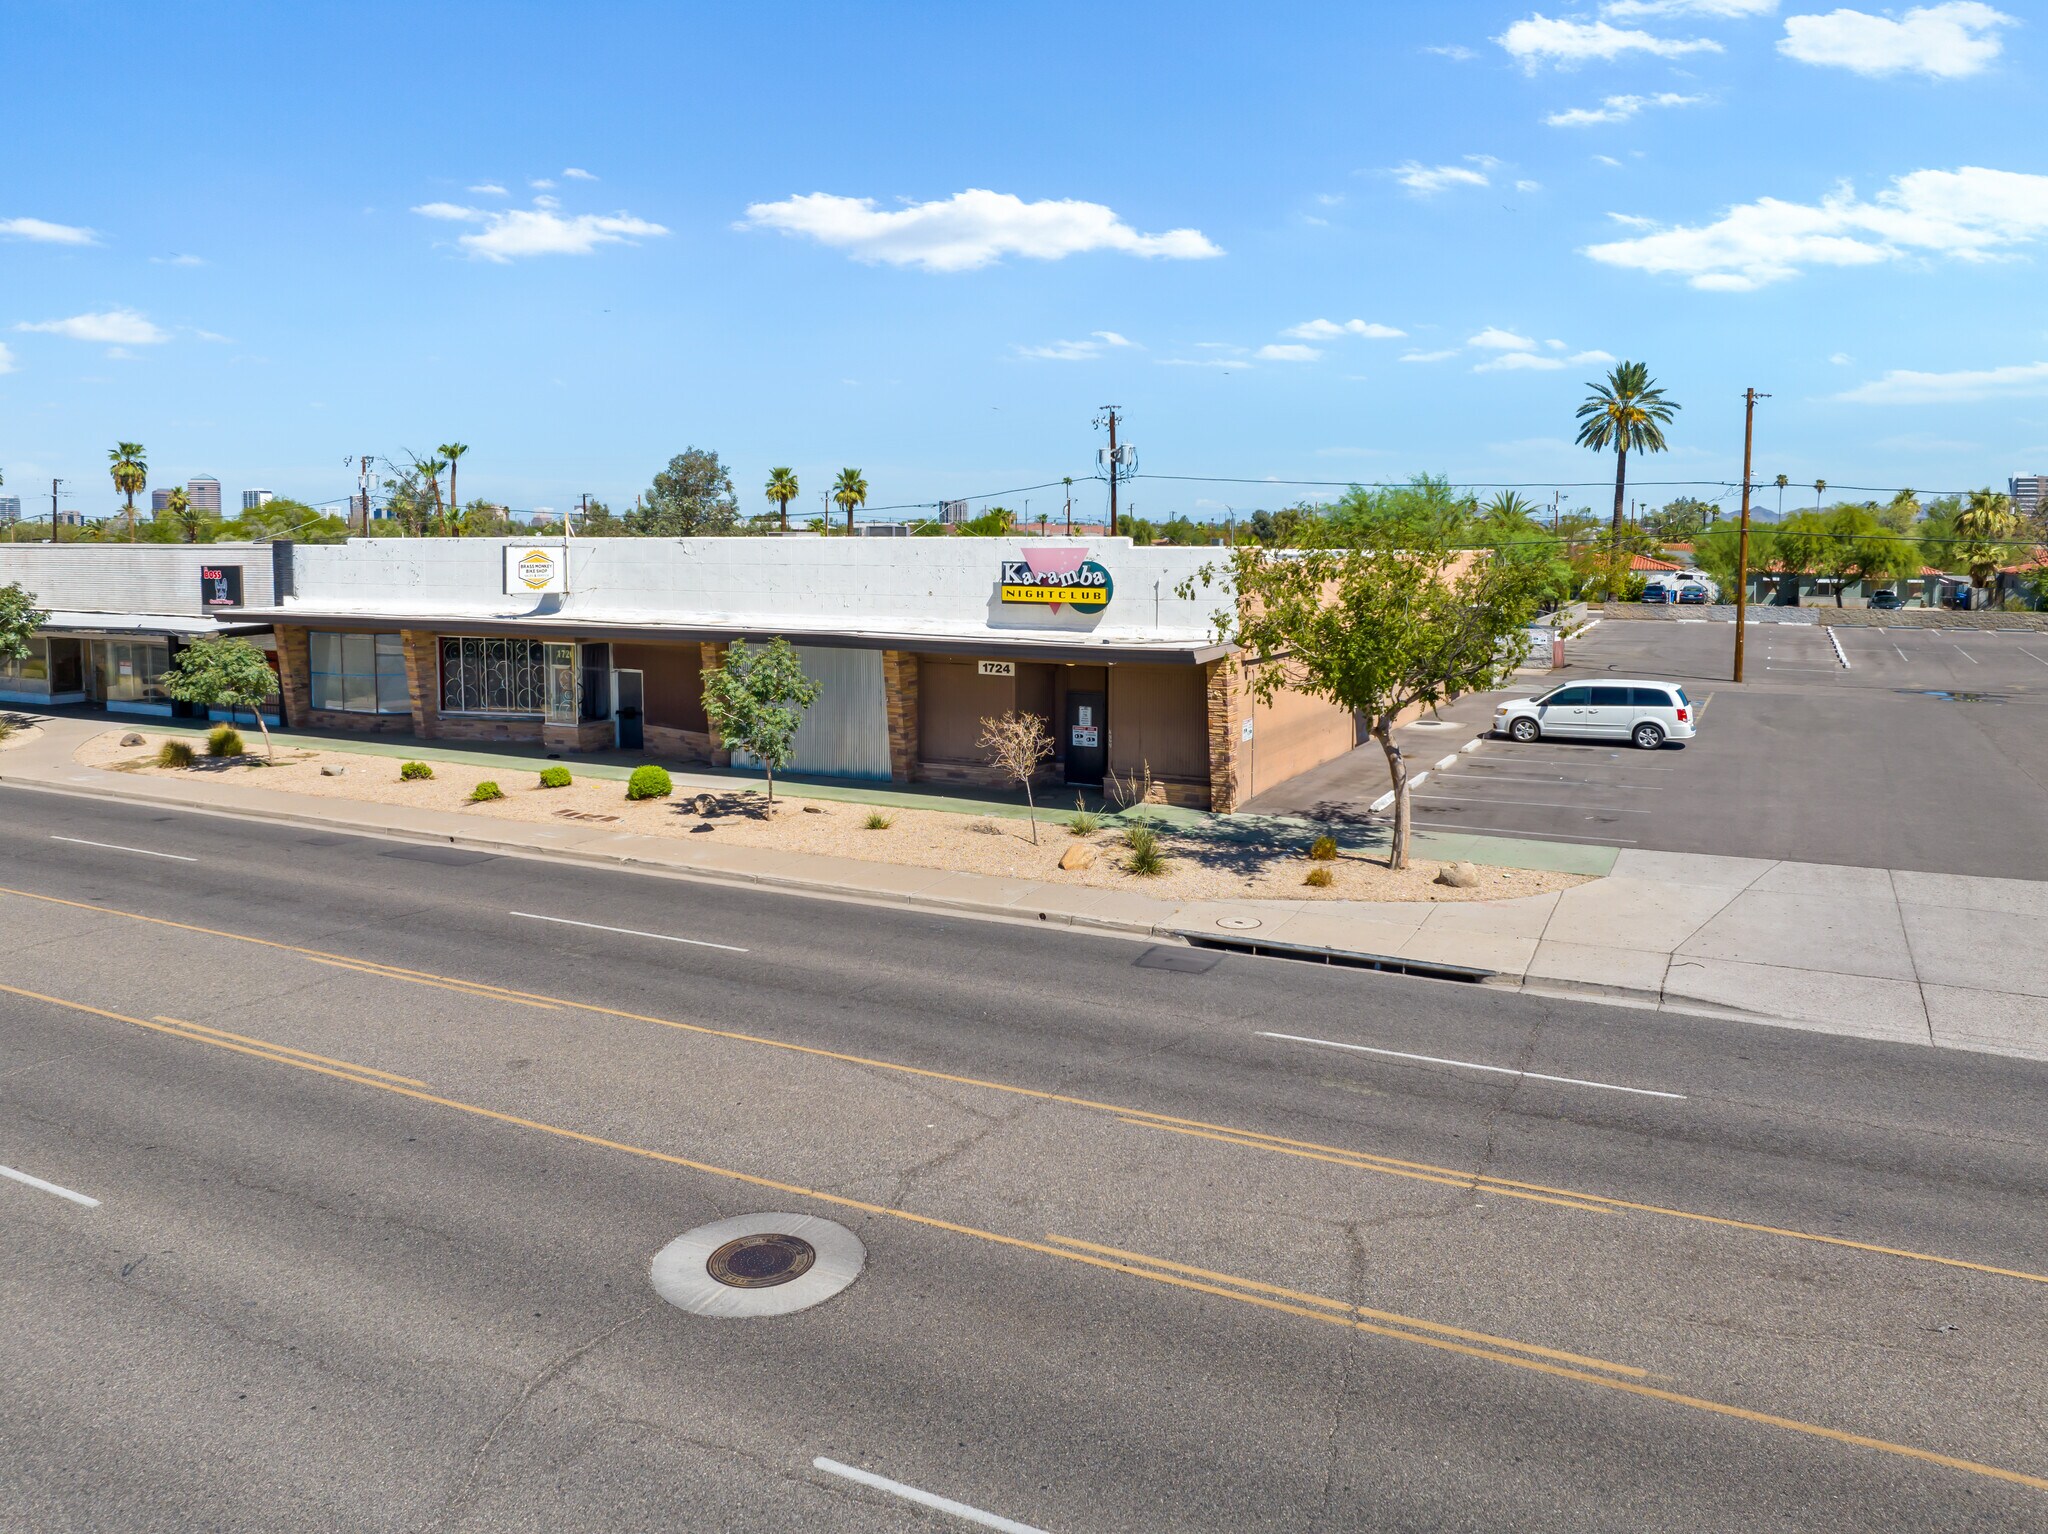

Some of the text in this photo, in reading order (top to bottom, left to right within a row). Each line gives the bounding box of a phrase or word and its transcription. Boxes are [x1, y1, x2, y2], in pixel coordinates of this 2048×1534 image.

[204, 570, 222, 579] BOSS
[1003, 562, 1106, 587] Karamba
[1006, 589, 1101, 600] NIGHTCLUB
[982, 662, 1011, 674] 1724
